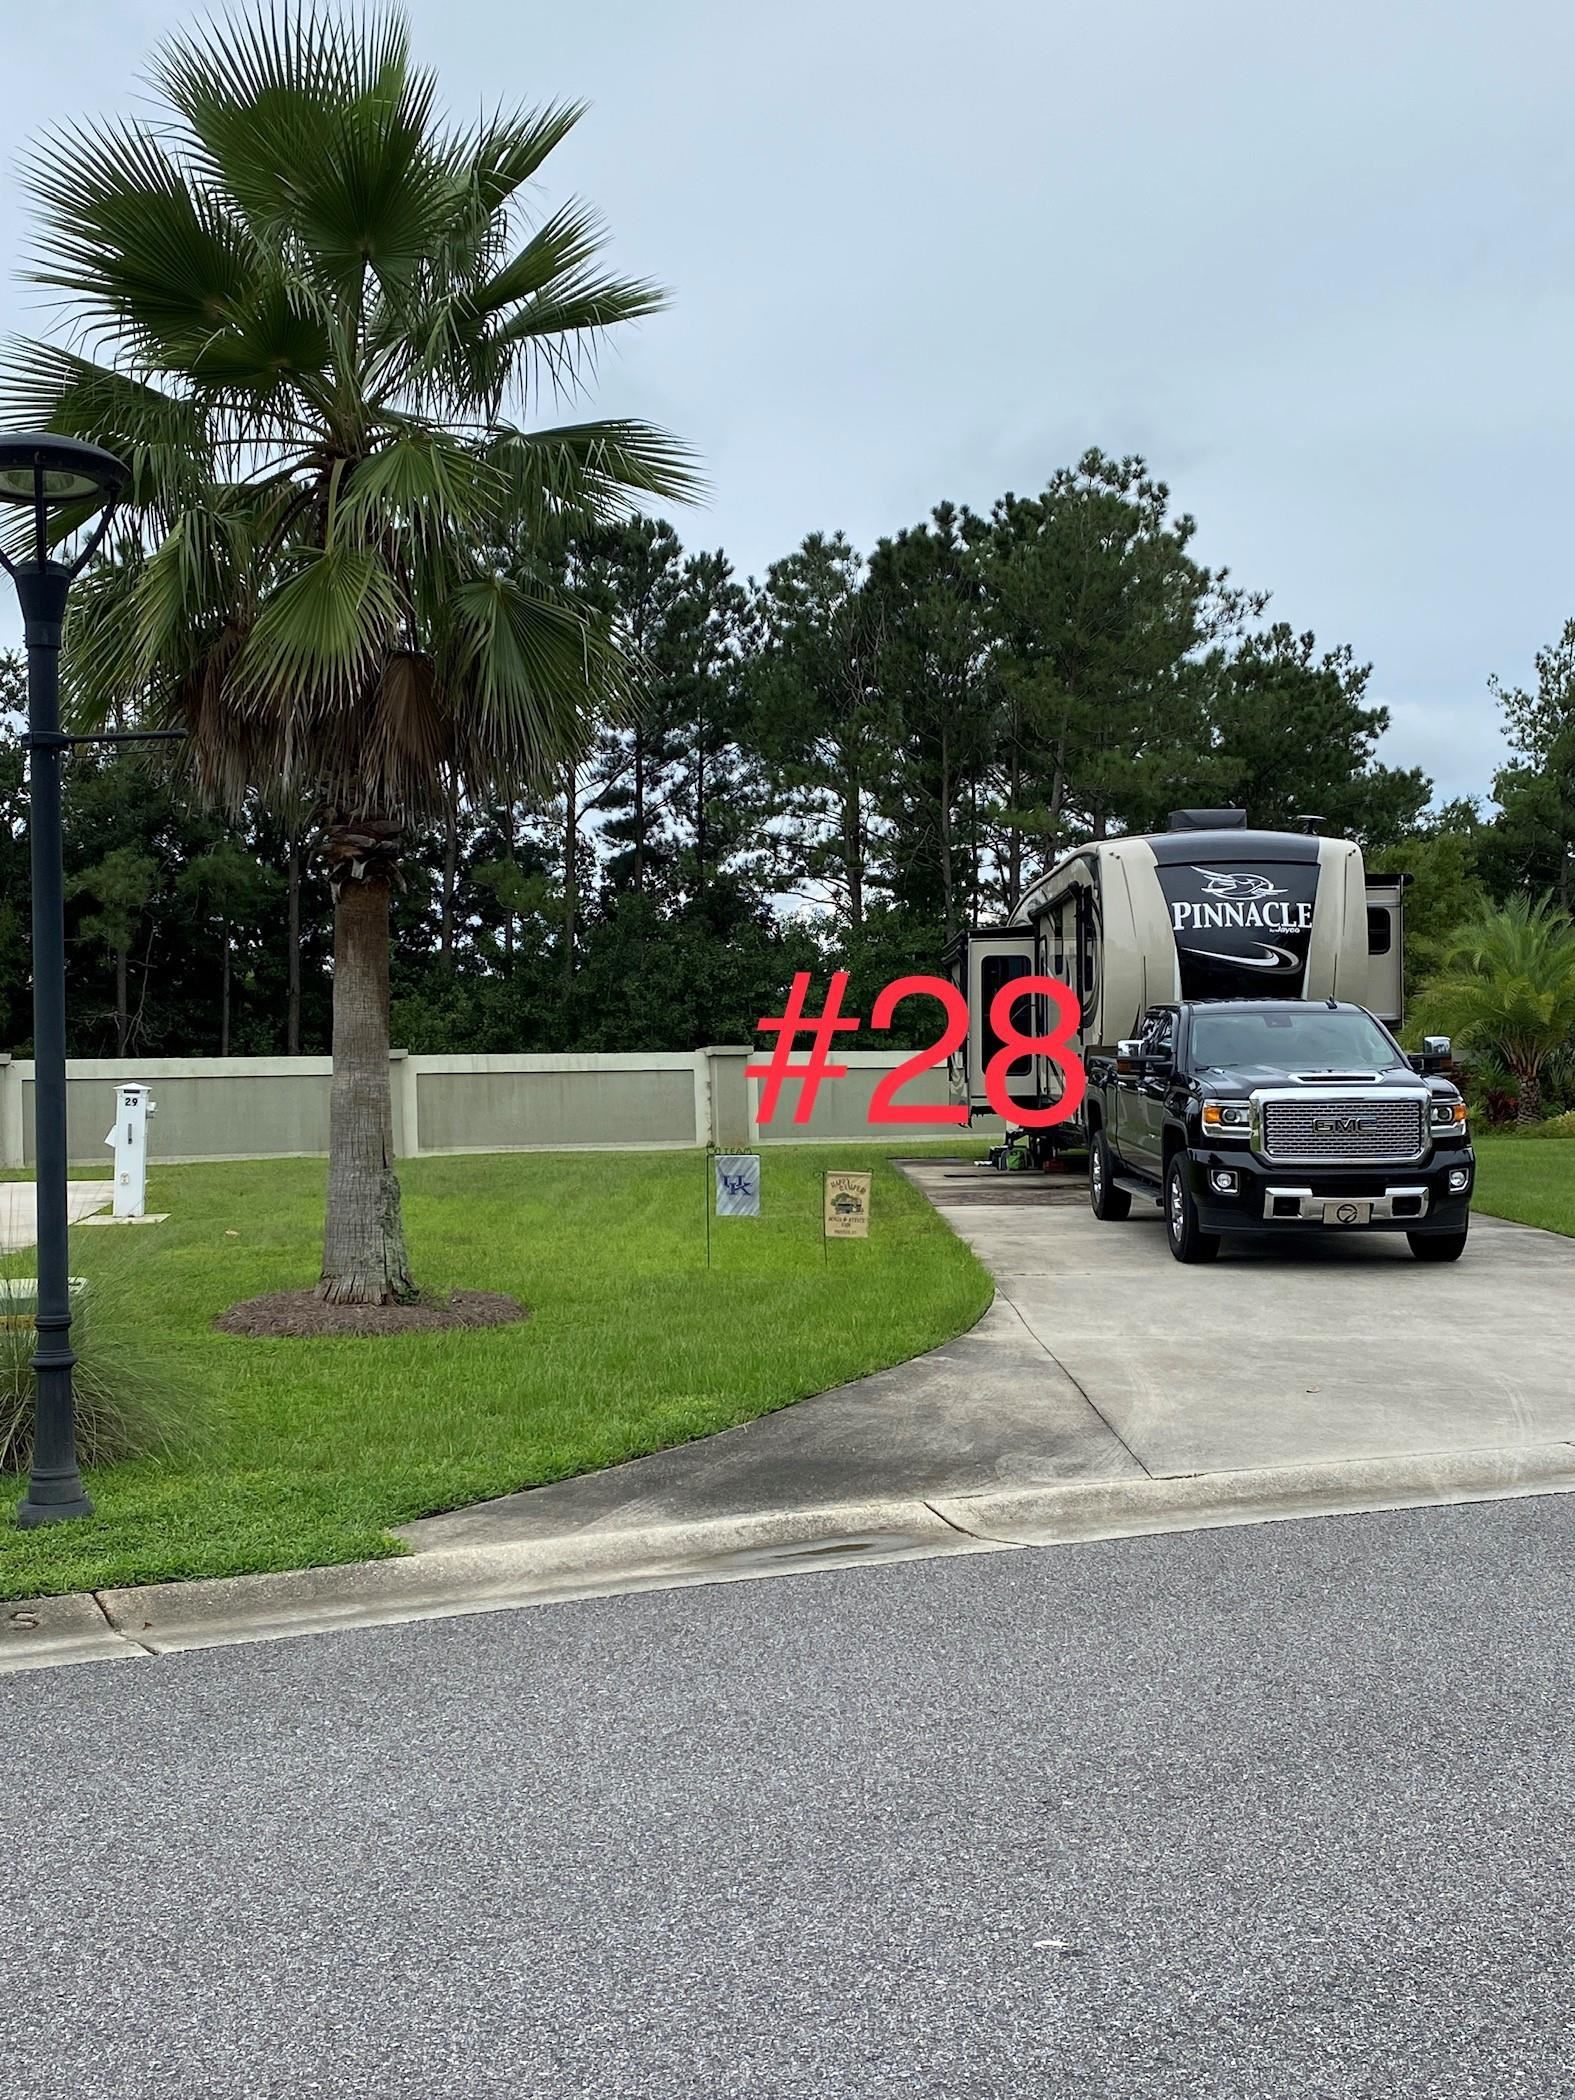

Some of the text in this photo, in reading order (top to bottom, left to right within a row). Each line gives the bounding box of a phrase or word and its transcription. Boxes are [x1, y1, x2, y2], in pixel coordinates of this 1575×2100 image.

[1171, 901, 1313, 931] PINNACLE
[1276, 925, 1301, 935] Jayco
[124, 1097, 139, 1107] 29
[1312, 1117, 1378, 1134] GMC
[722, 1174, 753, 1196] UK
